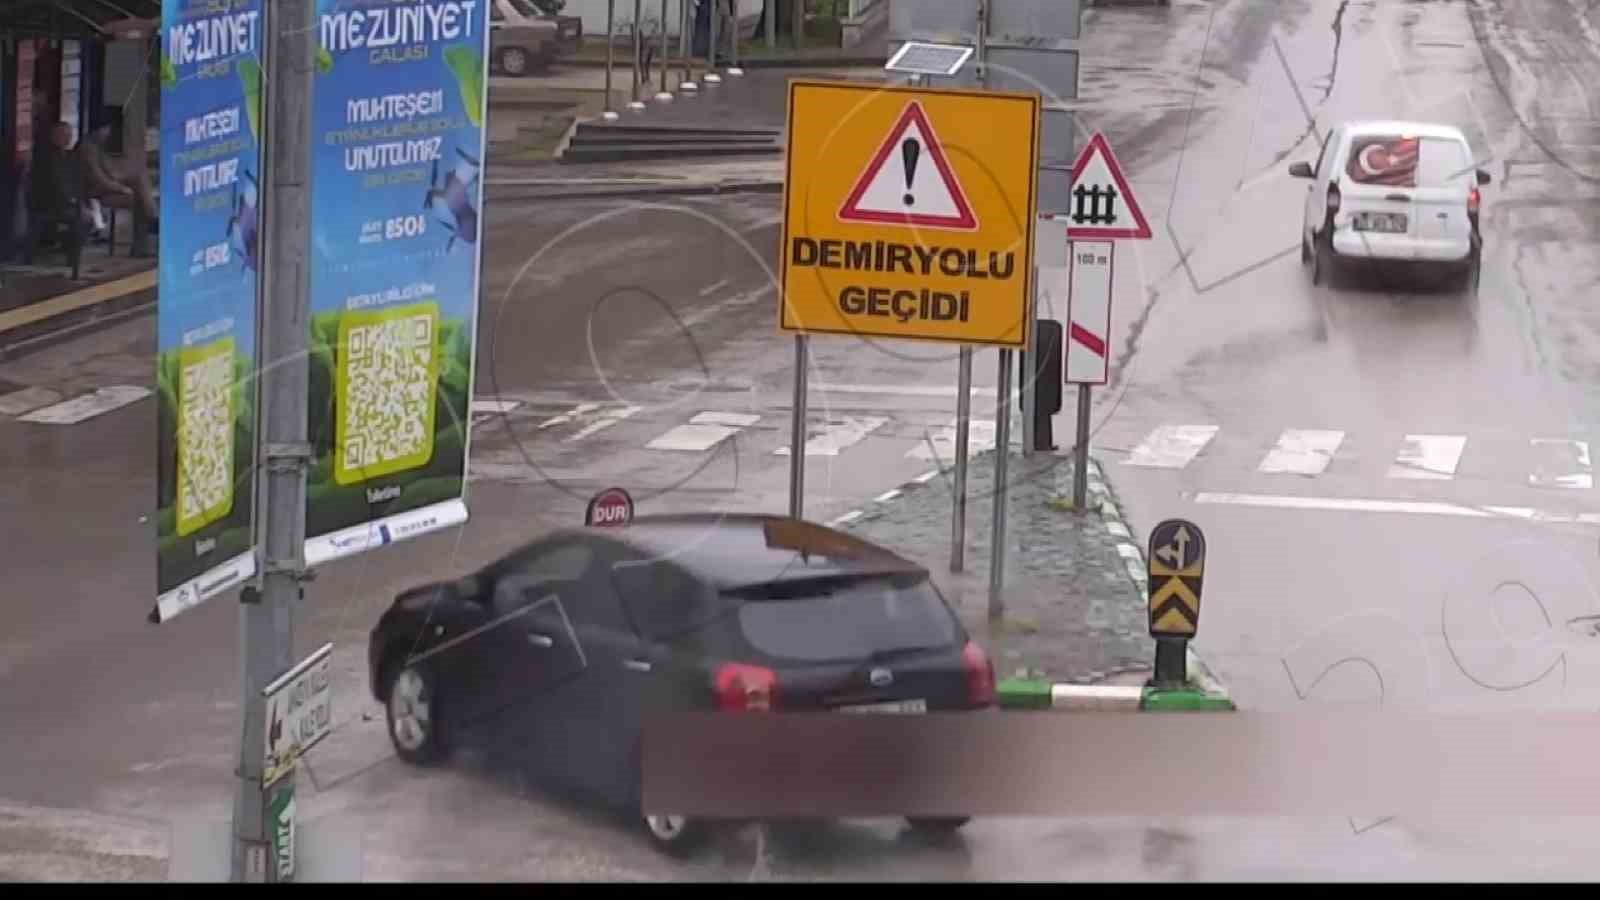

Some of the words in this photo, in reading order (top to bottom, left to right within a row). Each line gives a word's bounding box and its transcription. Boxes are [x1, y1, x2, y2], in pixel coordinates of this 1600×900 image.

[320, 0, 476, 50] MEZUNİYET
[791, 236, 1015, 280] DEMİRYOLU
[1077, 252, 1095, 266] 100
[838, 285, 970, 323] GEÇİDİ
[594, 505, 626, 523] DUR
